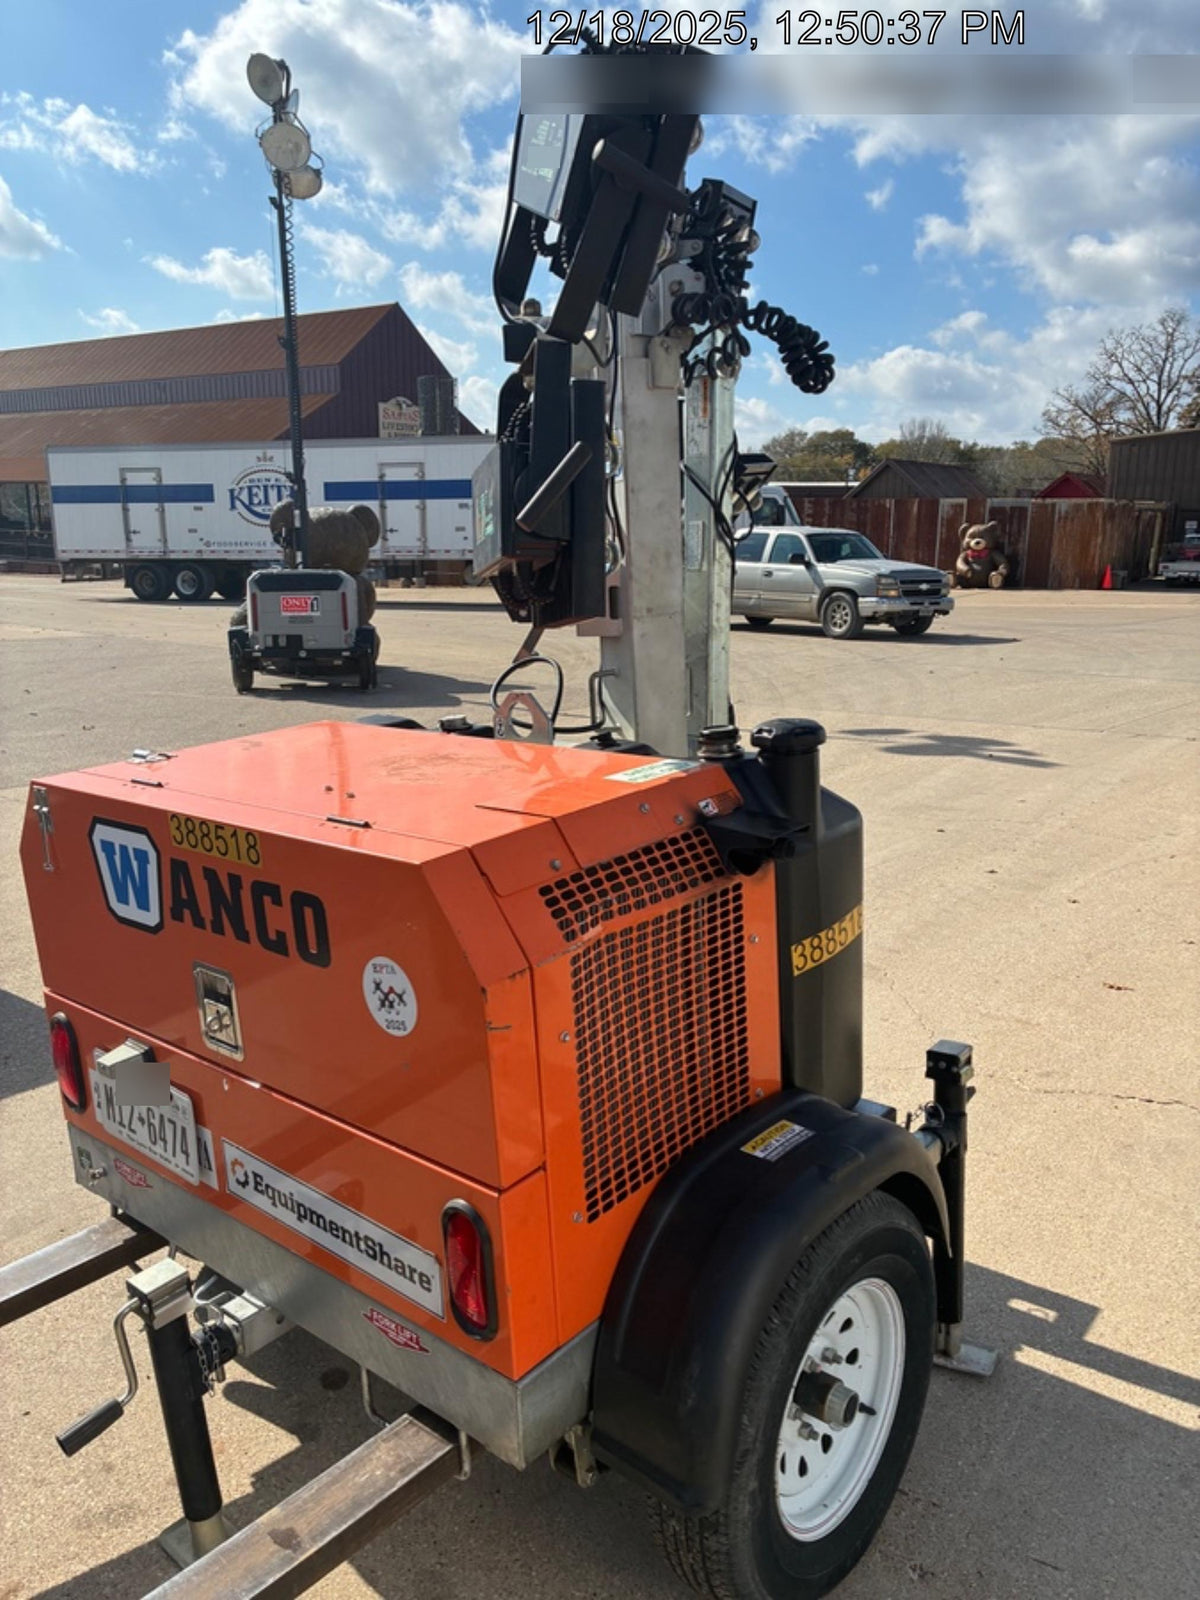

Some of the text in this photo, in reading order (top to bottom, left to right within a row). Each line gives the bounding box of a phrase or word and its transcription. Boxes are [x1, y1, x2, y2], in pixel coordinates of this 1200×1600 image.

[169, 813, 261, 866] 388518
[98, 837, 332, 969] WANCO
[251, 1170, 432, 1293] EquipmentShare
